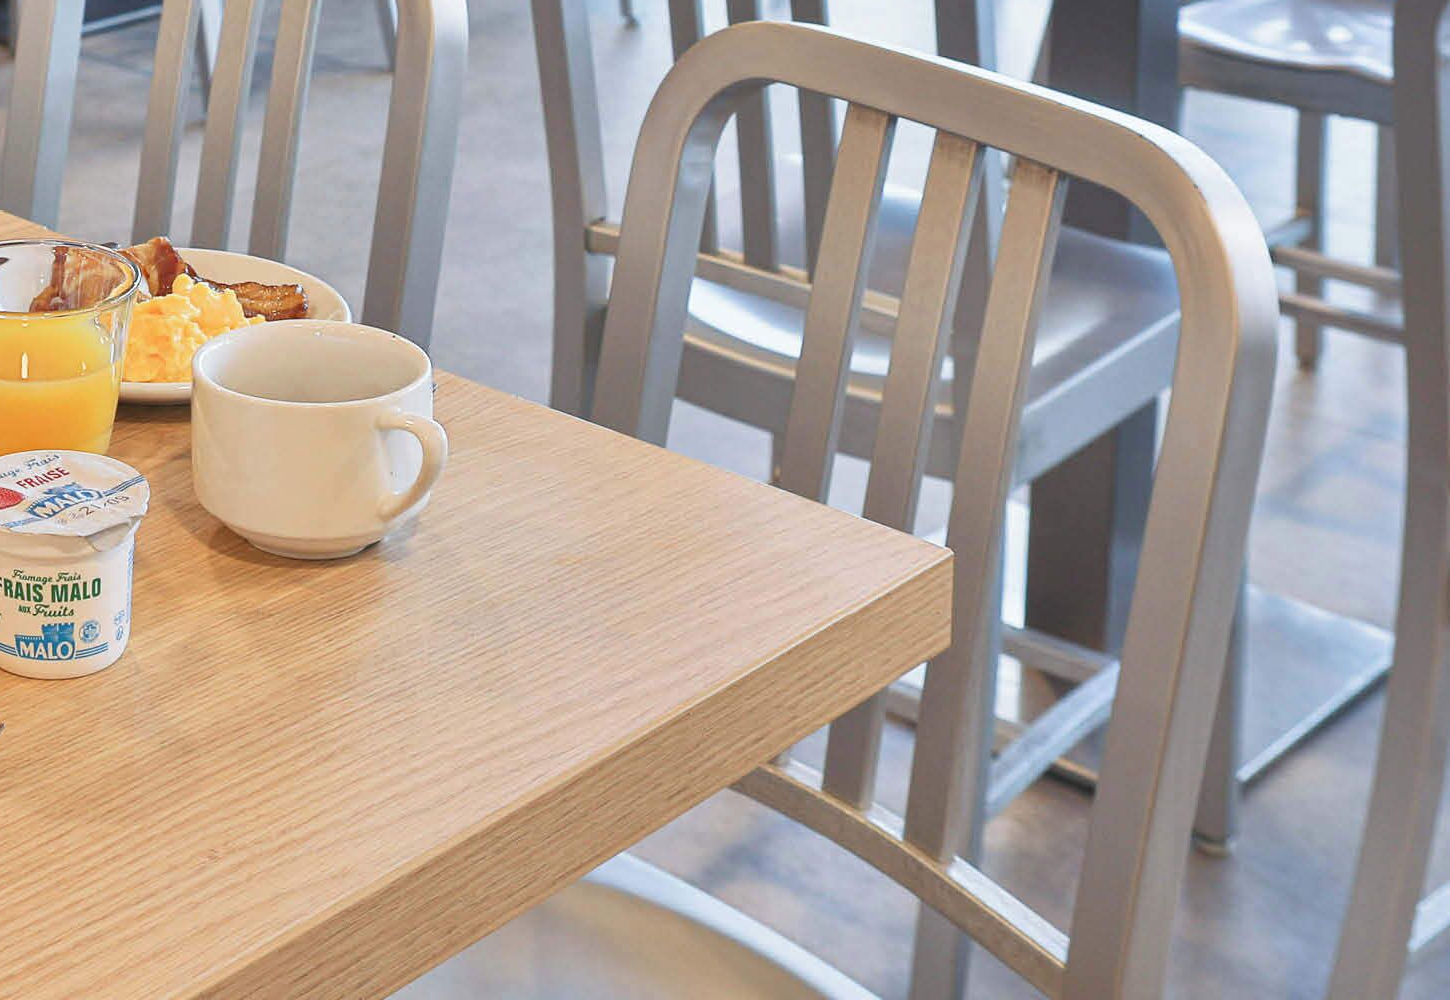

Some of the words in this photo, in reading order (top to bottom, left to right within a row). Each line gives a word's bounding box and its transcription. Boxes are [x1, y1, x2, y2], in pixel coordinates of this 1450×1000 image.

[16, 466, 70, 490] FRAISE
[32, 487, 101, 519] MALO
[12, 569, 54, 585] Fromage
[56, 572, 81, 582] Frais
[51, 577, 102, 603] MALO
[32, 603, 75, 618] Fruits
[19, 641, 74, 660] MALO
